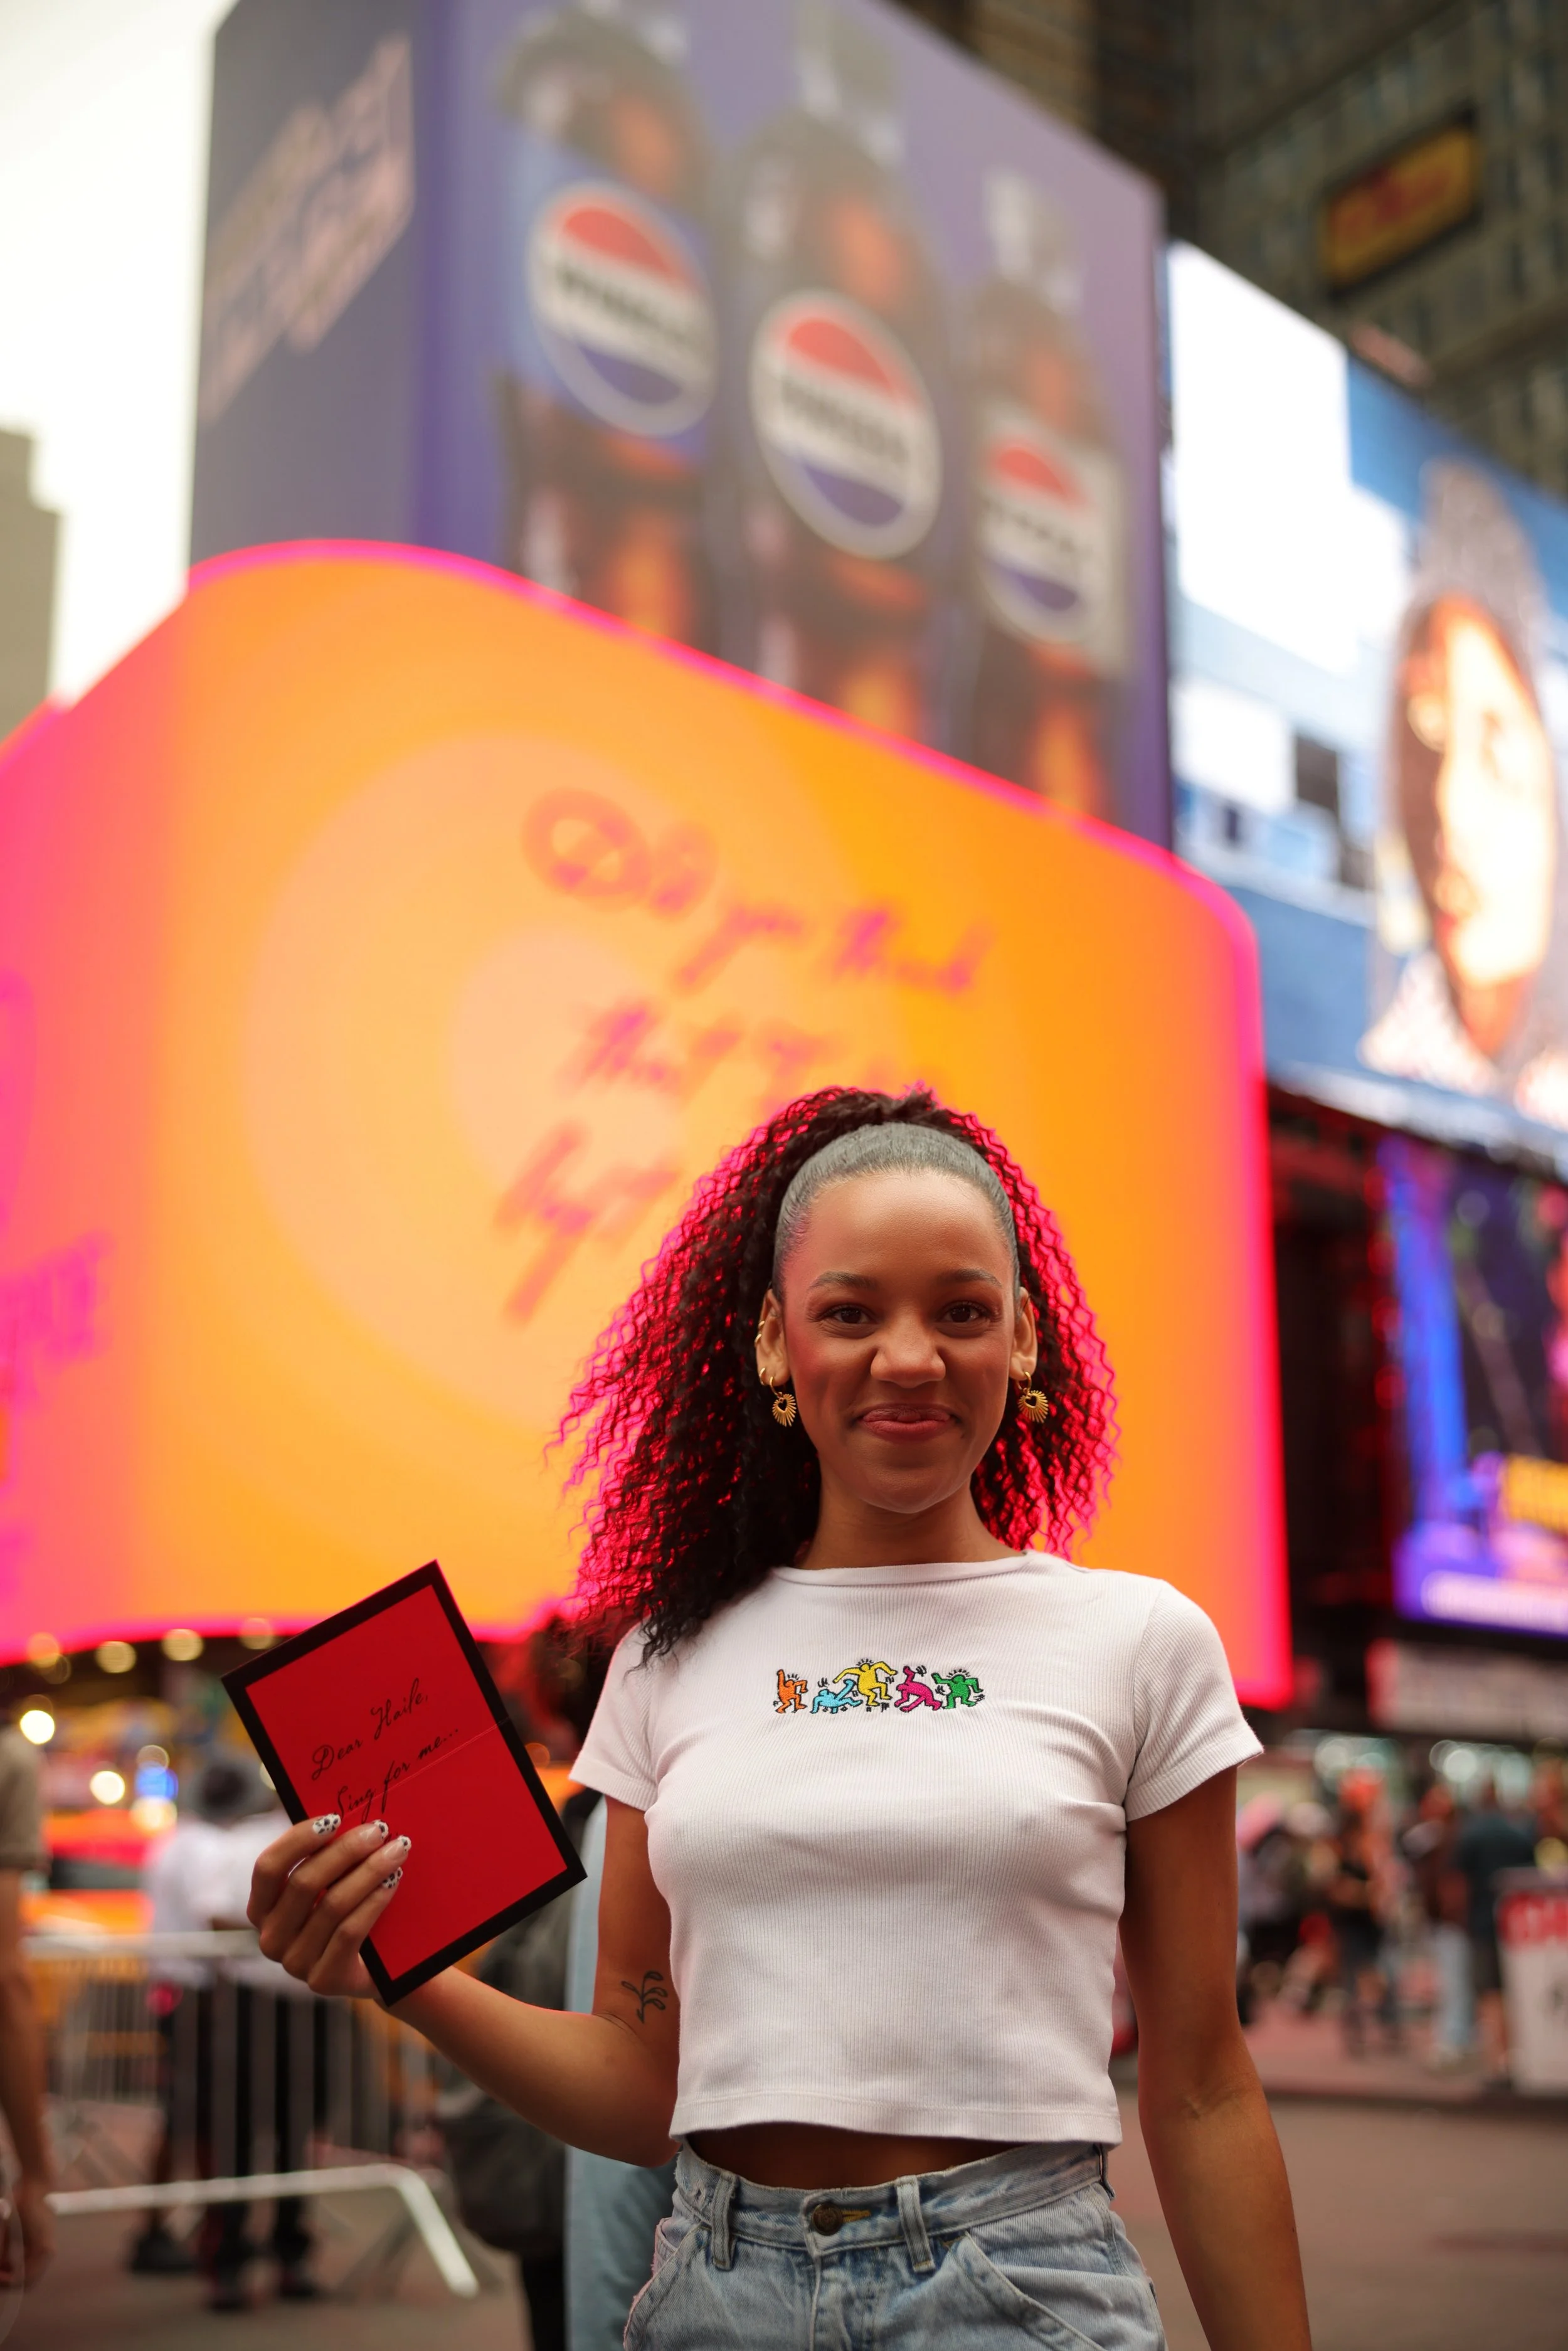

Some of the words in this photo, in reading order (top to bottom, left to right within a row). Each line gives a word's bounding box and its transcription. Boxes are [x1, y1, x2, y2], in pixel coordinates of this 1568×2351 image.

[312, 1738, 363, 1780] Dear
[337, 1785, 376, 1824] Sing
[381, 1760, 410, 1813] for
